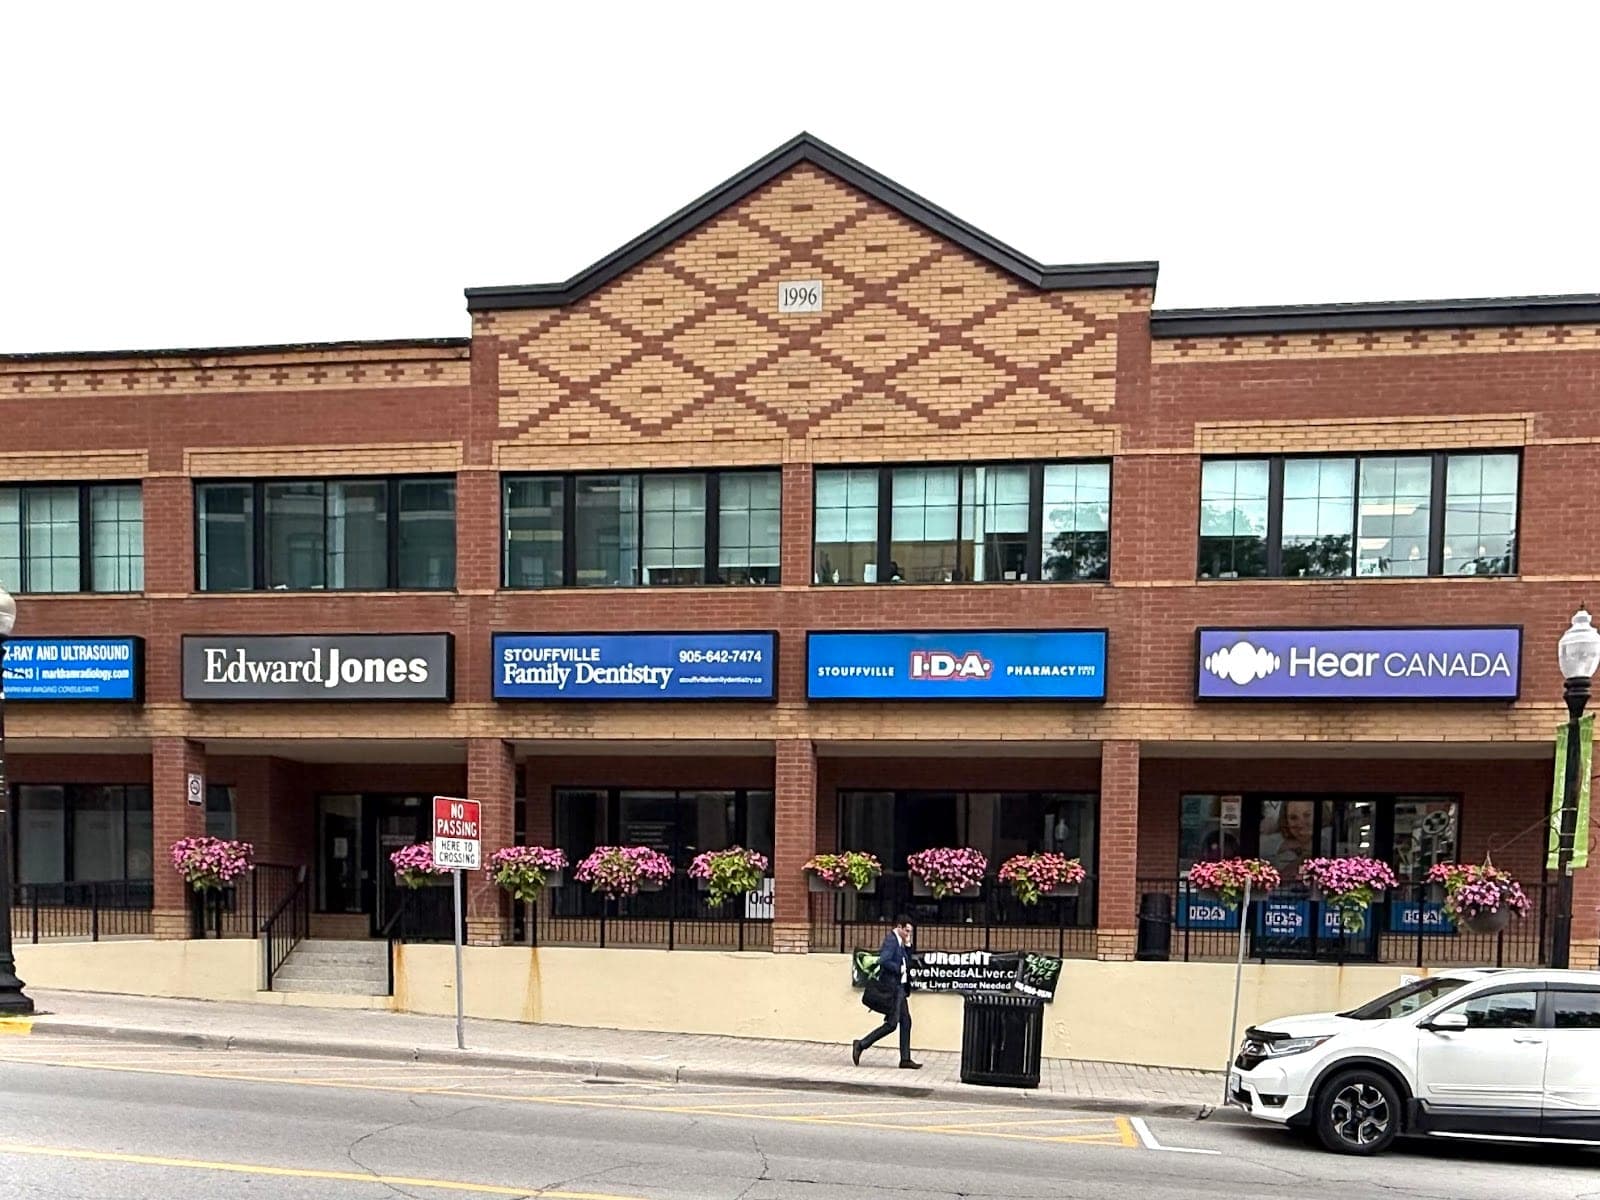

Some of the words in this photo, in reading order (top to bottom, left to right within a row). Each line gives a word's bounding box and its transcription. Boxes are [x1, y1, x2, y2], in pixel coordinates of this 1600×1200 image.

[784, 286, 817, 306] 1996
[36, 645, 58, 661] AND
[61, 644, 129, 661] ULTRASOUND
[503, 648, 601, 661] STOUFFVILLE
[679, 650, 762, 662] 905-642-7474
[203, 648, 323, 683] Edward
[324, 648, 429, 688] Jones
[1289, 646, 1380, 677] Hear
[1383, 651, 1512, 678] CANADA
[503, 662, 572, 690] Family
[574, 662, 674, 690] Dentistry
[817, 666, 895, 677] STOUFFVILLE
[1006, 665, 1076, 676] PHARMACY
[450, 803, 464, 819] NO
[437, 818, 477, 837] PASSING
[441, 839, 460, 852] HERE
[464, 841, 473, 852] TO
[439, 851, 475, 864] CROSSING
[909, 966, 1018, 980] eveNeedsALiver.c
[910, 981, 928, 989] ving
[929, 980, 950, 989] Liver
[952, 981, 977, 990] Donor
[979, 981, 1012, 990] Needed
